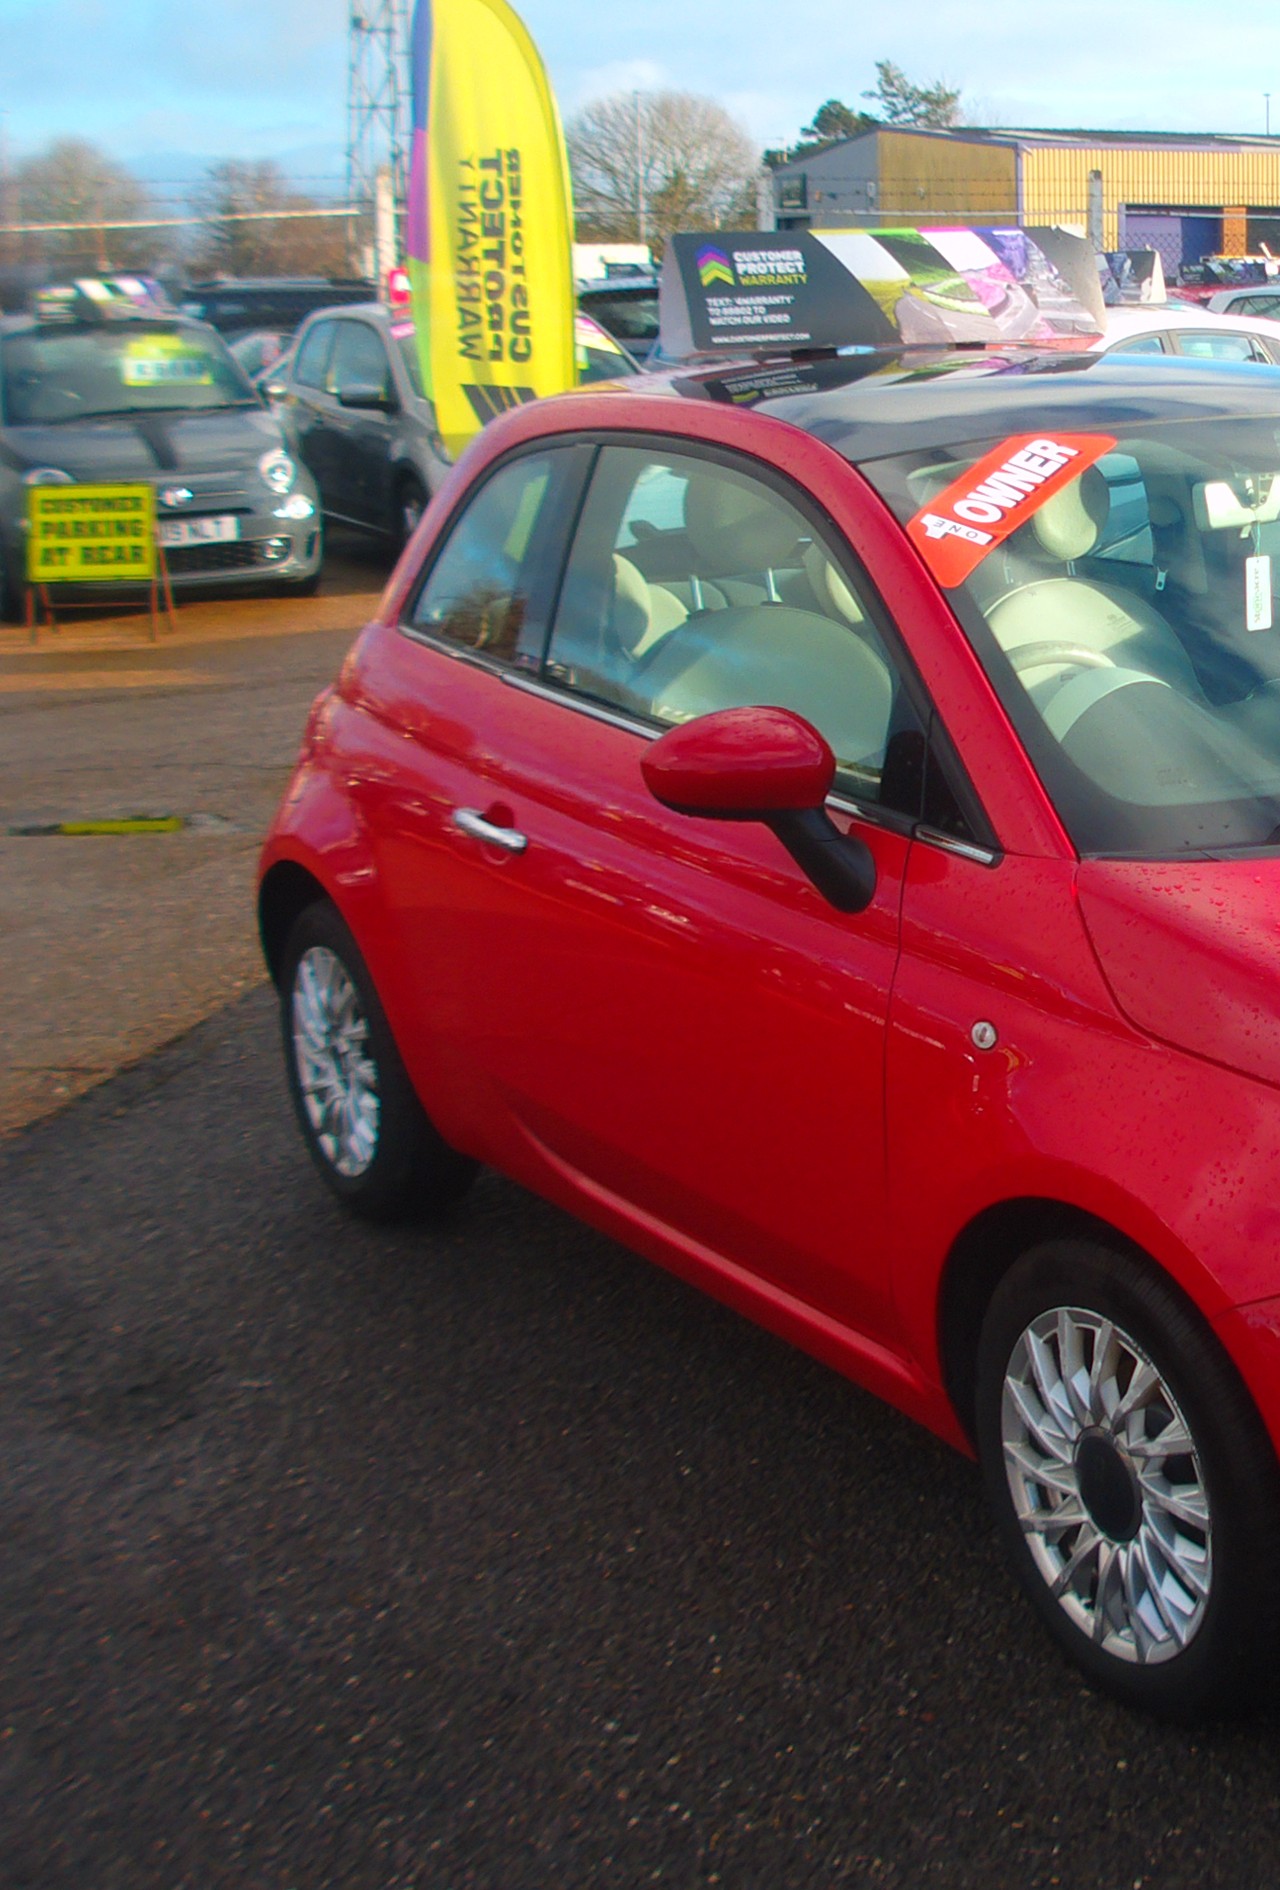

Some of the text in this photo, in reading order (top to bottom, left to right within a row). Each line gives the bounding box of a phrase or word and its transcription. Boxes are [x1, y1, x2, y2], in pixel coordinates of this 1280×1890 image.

[732, 250, 803, 262] CUSTOMER
[735, 261, 806, 275] PROTECT
[740, 274, 807, 286] WARRANTY
[953, 439, 1080, 523] OWNER
